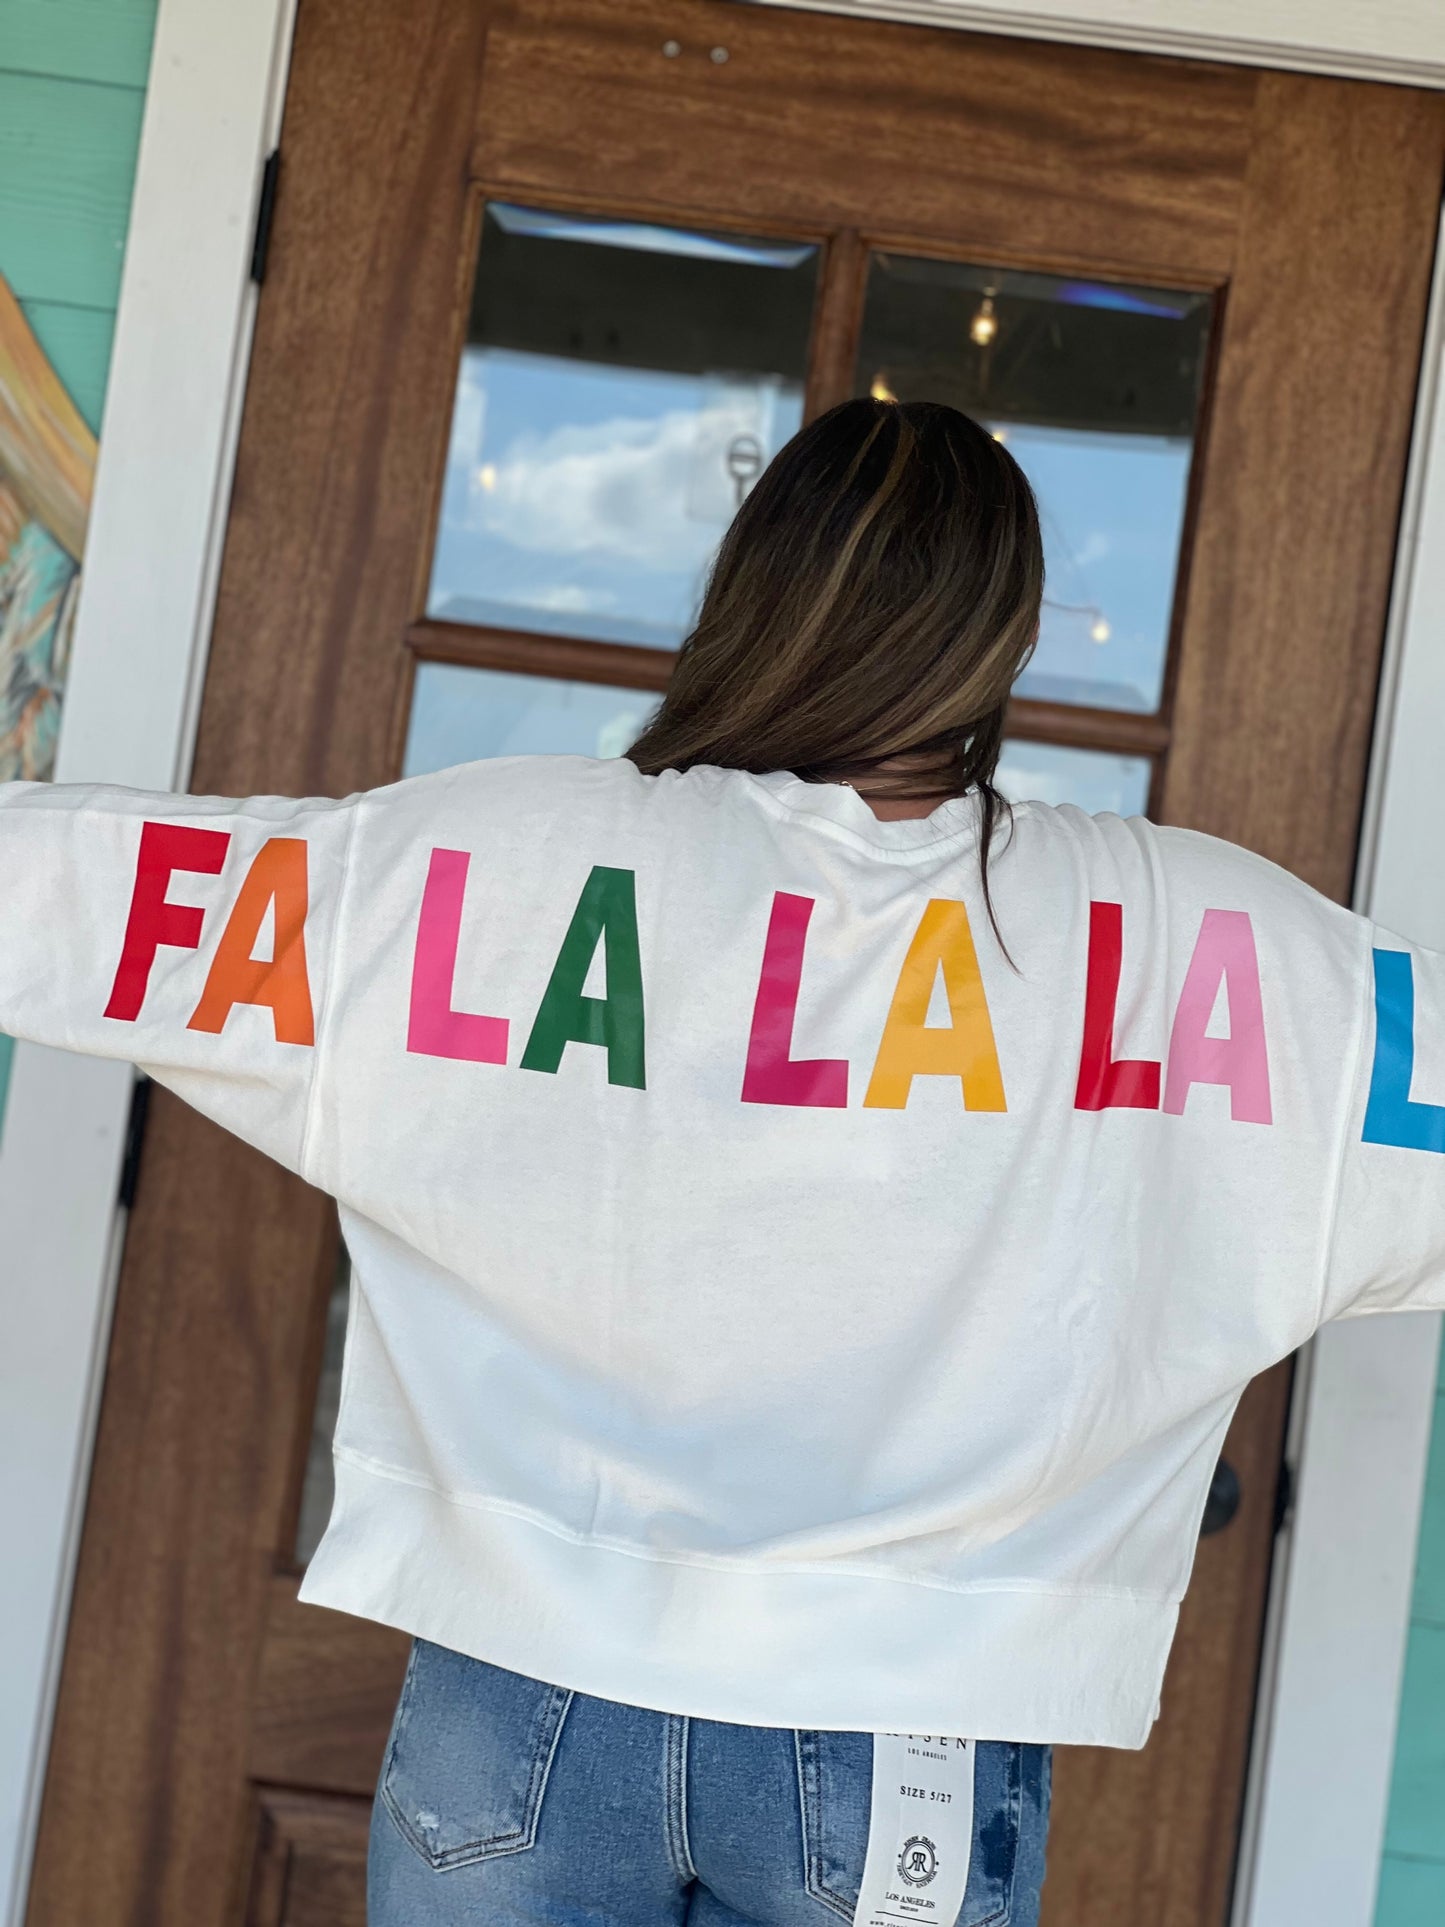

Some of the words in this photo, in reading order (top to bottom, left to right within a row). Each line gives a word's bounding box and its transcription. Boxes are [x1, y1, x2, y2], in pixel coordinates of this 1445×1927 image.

[103, 821, 315, 1047] FA
[406, 847, 646, 1090] LA
[741, 891, 1008, 1112] LA
[1074, 900, 1273, 1124] LA
[900, 1785, 926, 1799] SIZE
[930, 1791, 952, 1804] 5/27
[885, 1891, 899, 1901] LOS
[900, 1895, 936, 1909] ANGELES
